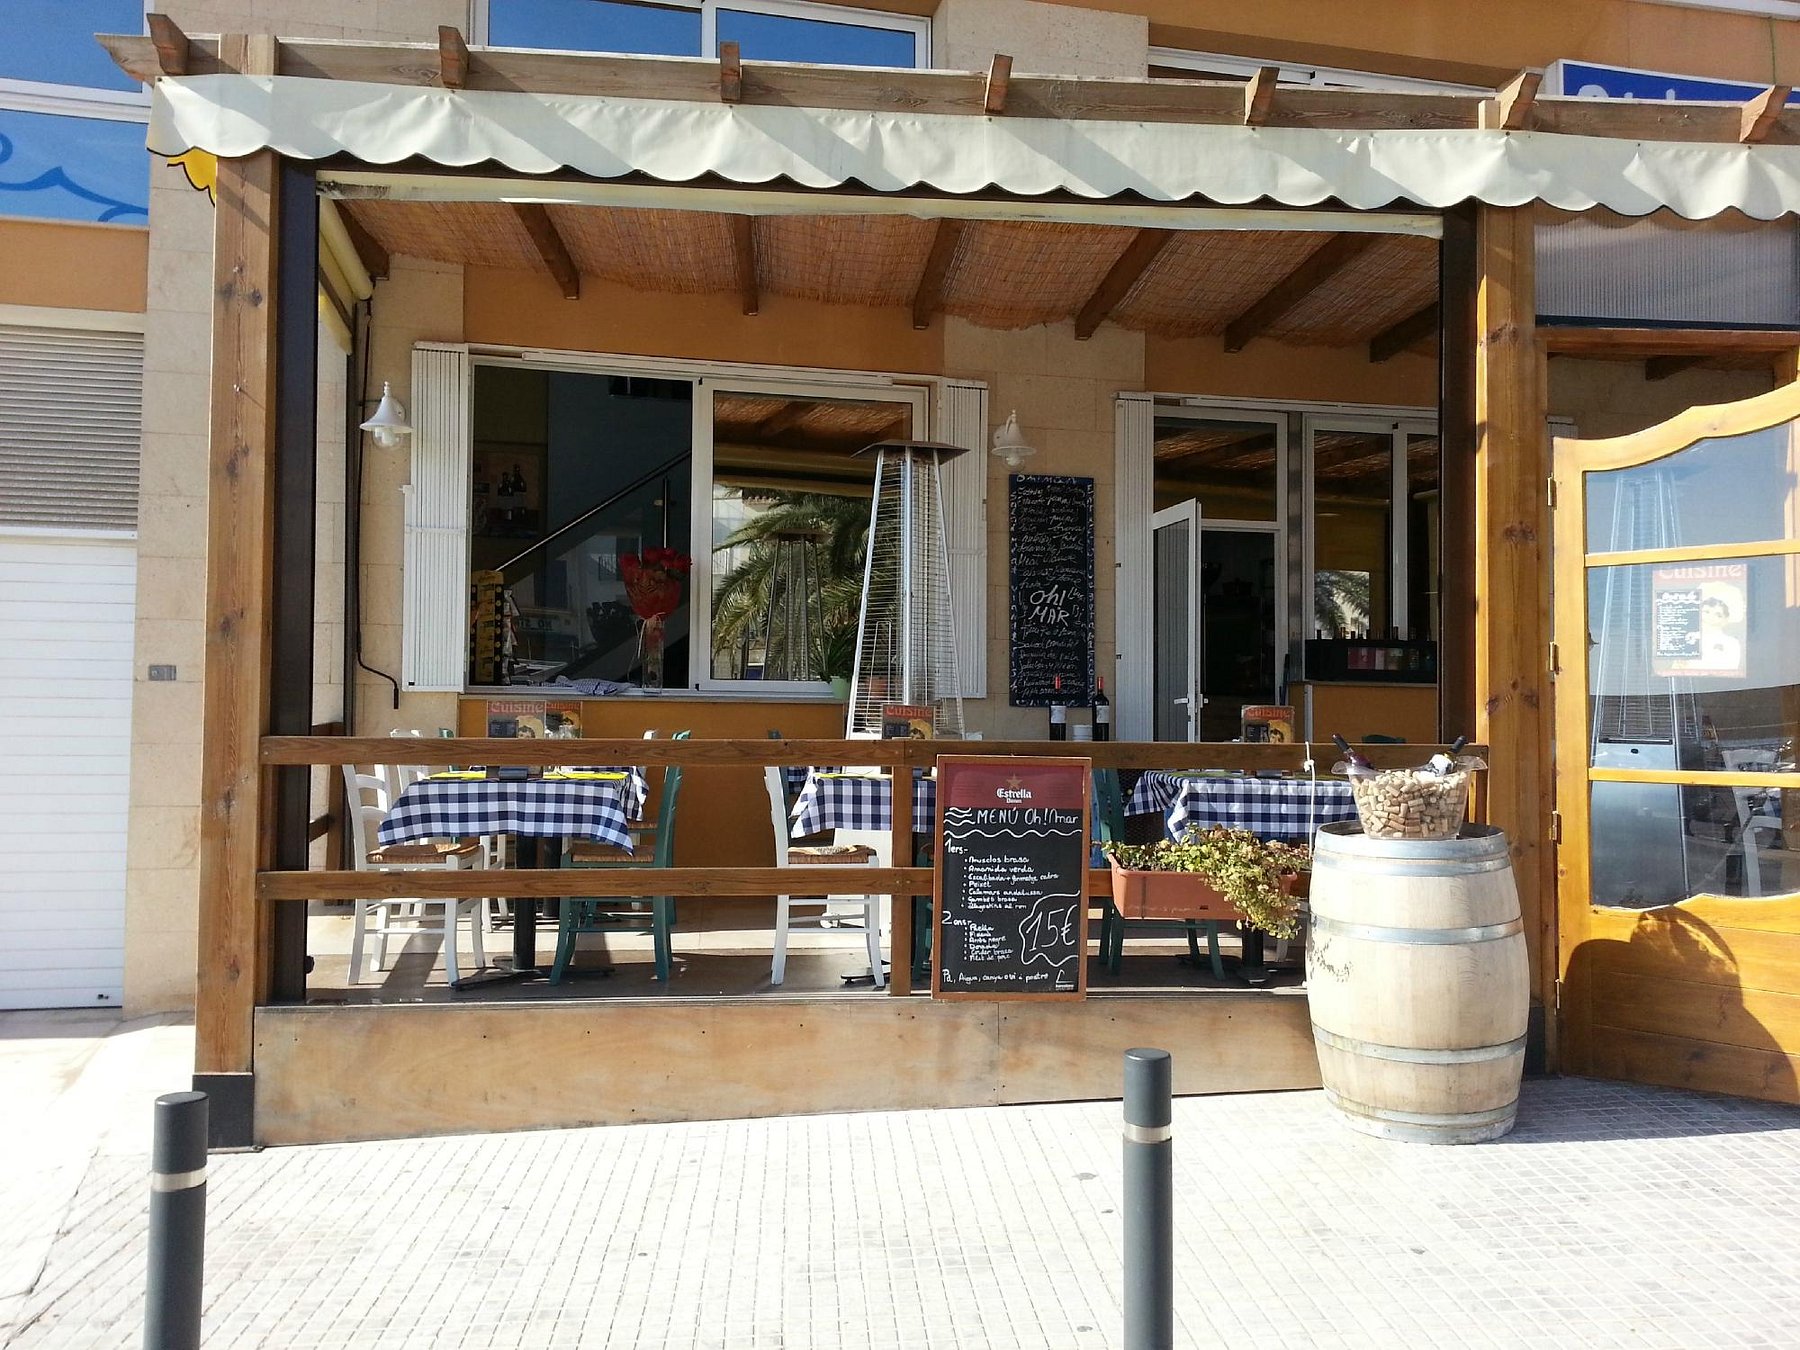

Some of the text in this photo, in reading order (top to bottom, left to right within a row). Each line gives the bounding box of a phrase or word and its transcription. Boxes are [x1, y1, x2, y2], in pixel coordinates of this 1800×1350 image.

[1027, 605, 1070, 627] MAR
[490, 701, 544, 714] Cuisine
[886, 705, 933, 718] Cuisine
[996, 787, 1032, 799] Estrella
[977, 807, 1019, 825] MENÚ
[1004, 854, 1030, 863] brasa
[1026, 904, 1078, 952] 15€
